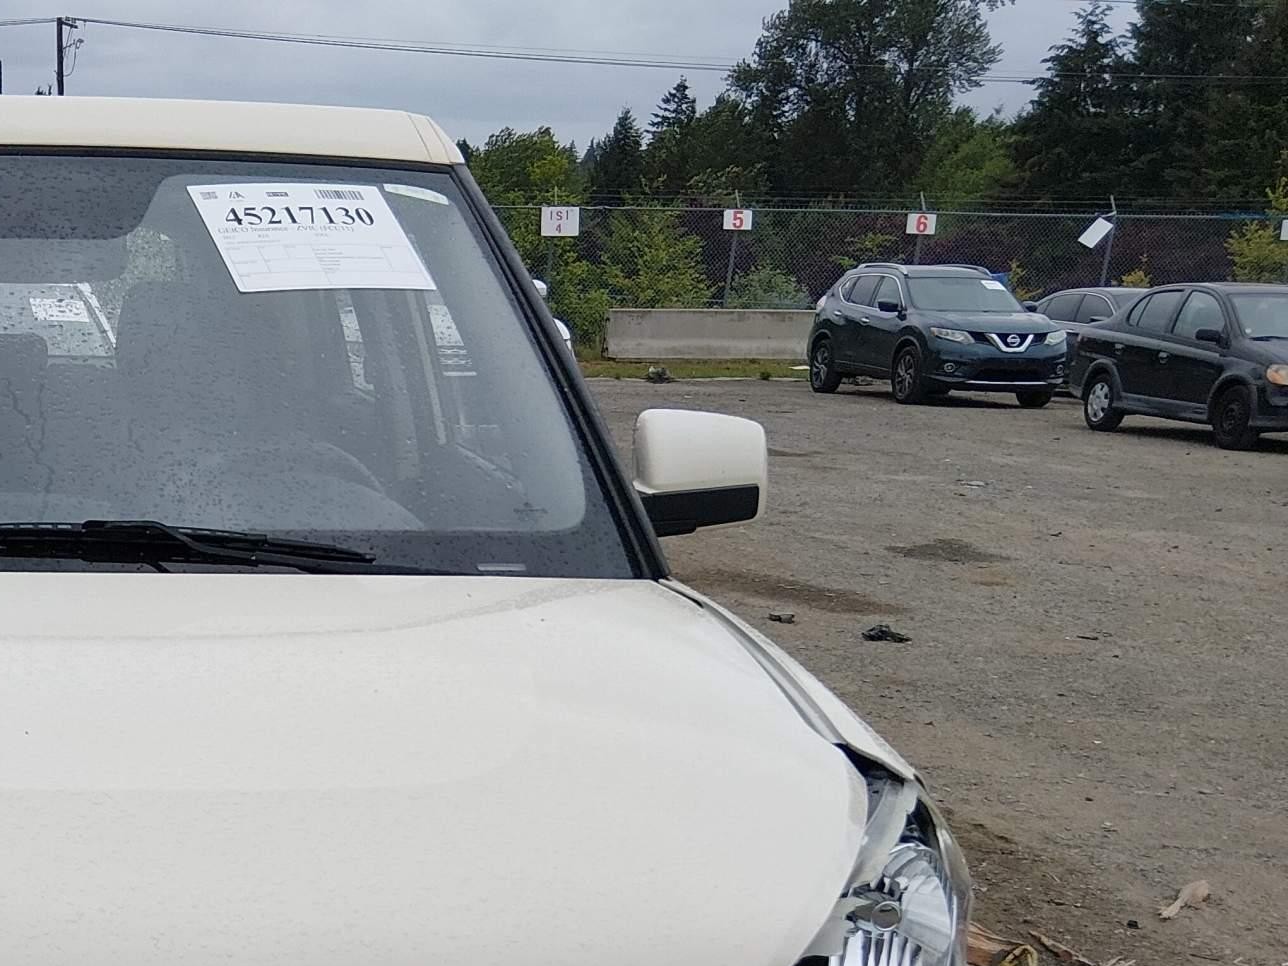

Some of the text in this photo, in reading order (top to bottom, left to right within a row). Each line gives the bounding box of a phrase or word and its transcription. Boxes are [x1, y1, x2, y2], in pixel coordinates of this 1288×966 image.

[225, 206, 375, 226] 45217130
[731, 211, 744, 229] 5
[915, 215, 929, 233] 6
